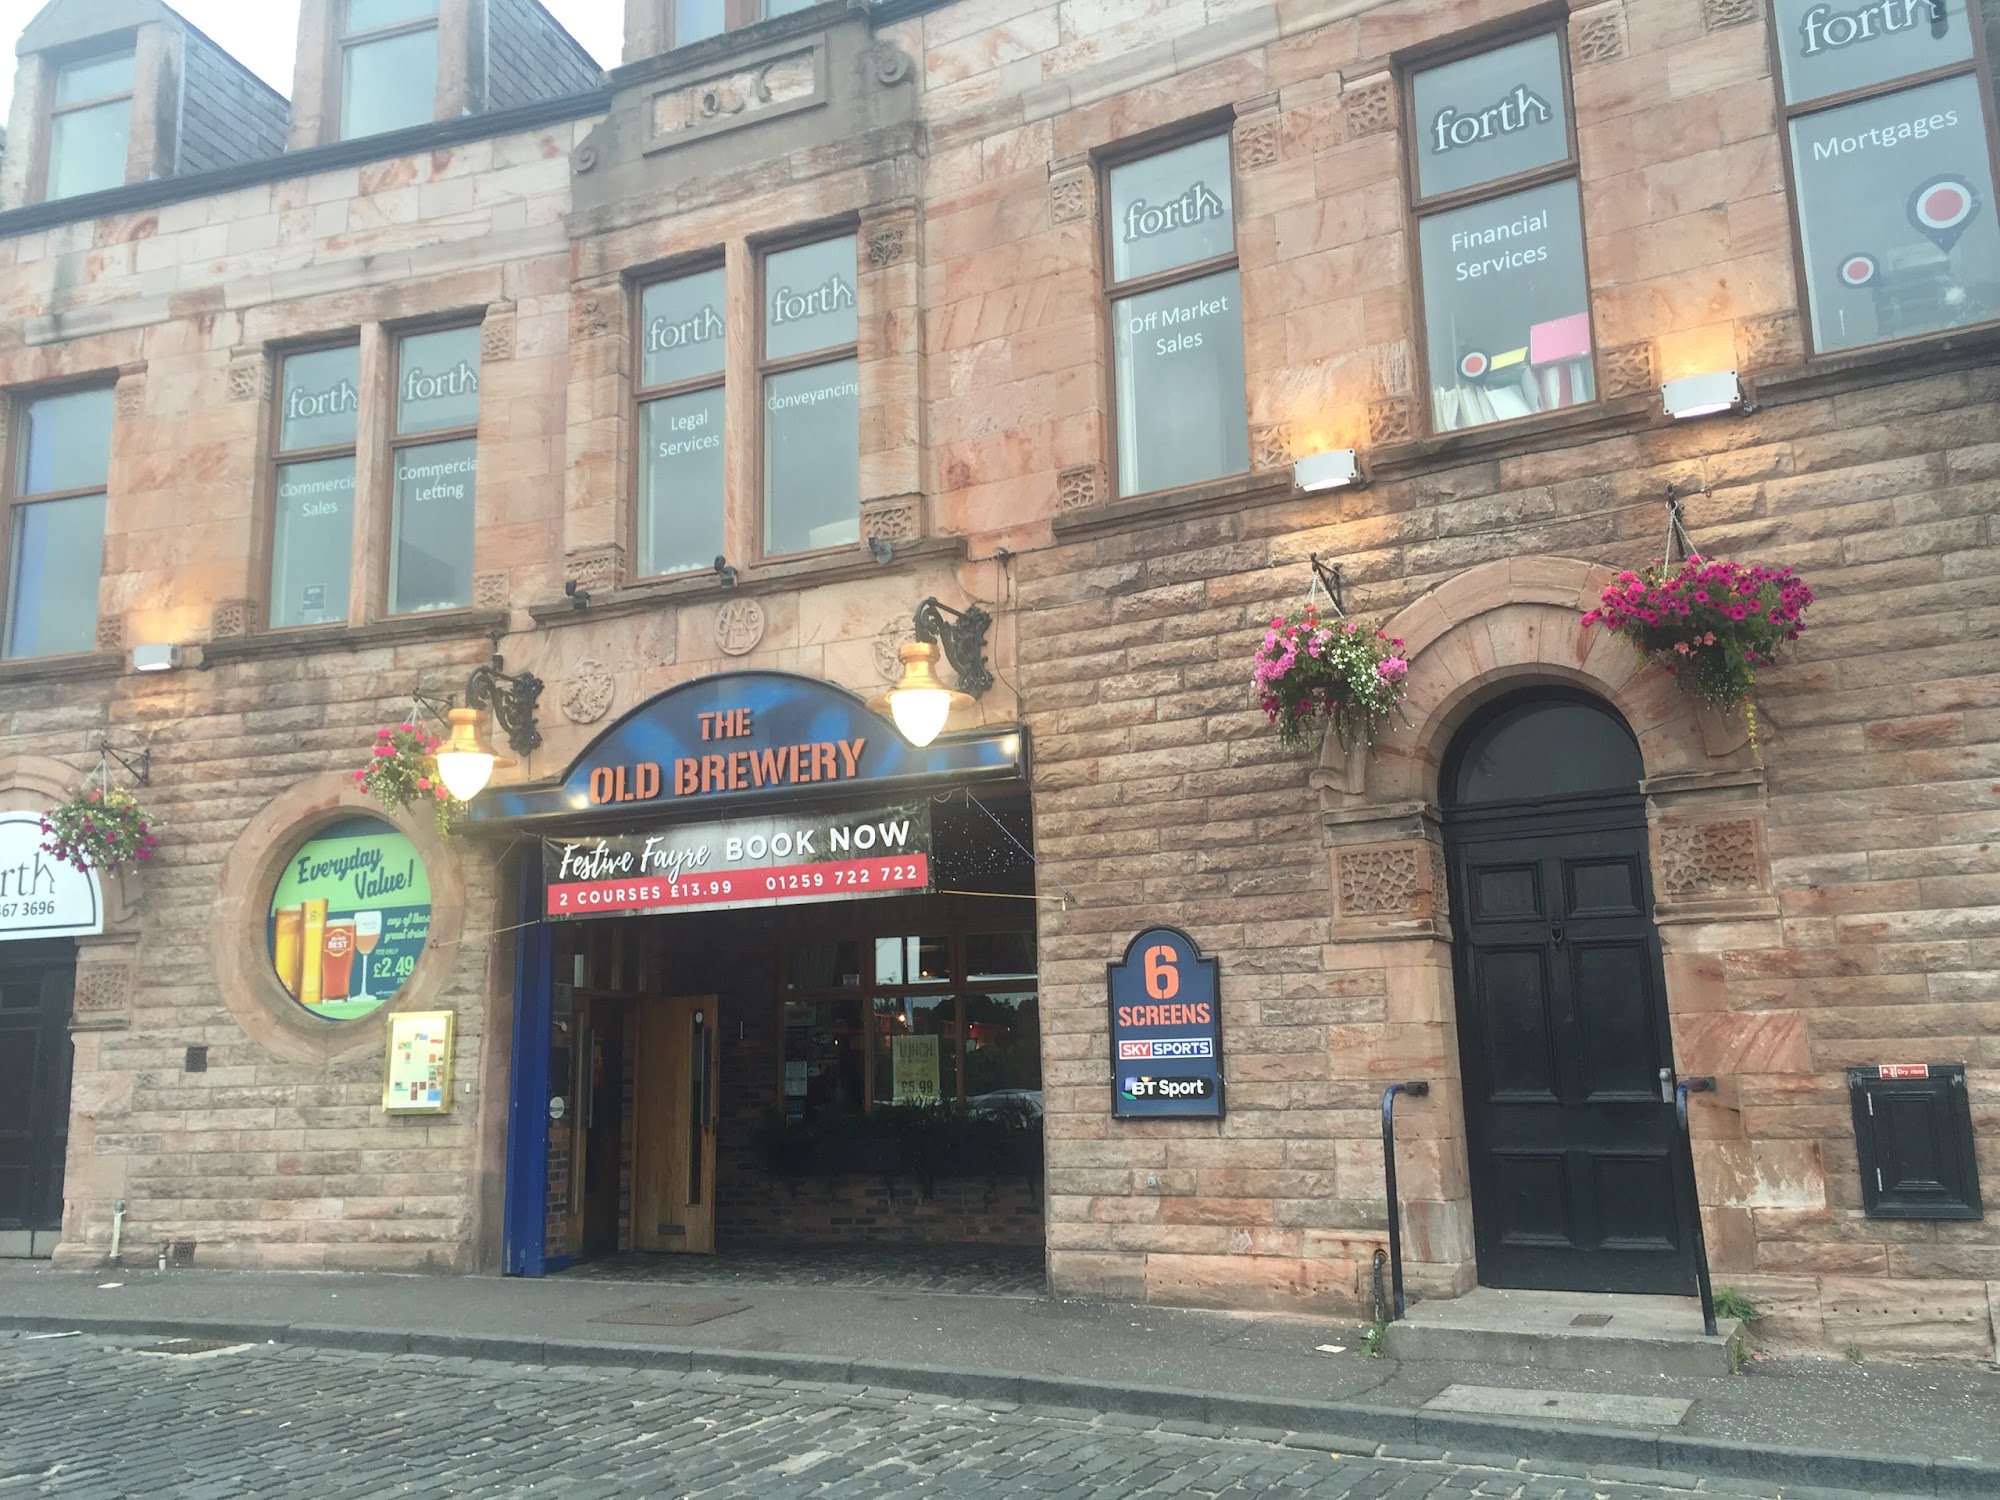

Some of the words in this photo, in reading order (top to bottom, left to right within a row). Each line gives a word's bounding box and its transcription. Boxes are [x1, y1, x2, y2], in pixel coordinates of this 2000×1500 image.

[1803, 0, 1940, 53] forth
[1435, 87, 1548, 151] forth
[1813, 110, 1958, 161] Mortgages
[1128, 184, 1219, 240] forth
[1451, 209, 1548, 252] Financial
[1456, 246, 1548, 281] Services
[774, 277, 854, 323] forth
[1130, 312, 1158, 334] Off
[1162, 296, 1228, 327] Market
[649, 307, 724, 351] forth
[1156, 332, 1203, 356] Sales
[288, 381, 357, 419] forth
[406, 363, 477, 400] forth
[670, 408, 708, 431] Legal
[659, 434, 720, 458] Services
[280, 473, 356, 498] Commercia
[398, 457, 478, 481] Commercia
[302, 501, 338, 517] Sales
[415, 484, 464, 501] Letting
[698, 708, 751, 741] THE
[589, 762, 660, 804] OLD
[674, 738, 866, 796] BREWERY
[297, 847, 383, 885] Everyday
[559, 839, 635, 880] Festive
[640, 836, 712, 885] Fayre
[726, 828, 815, 861] BOOK
[830, 820, 909, 852] NOW
[355, 859, 414, 900] Value!
[559, 893, 568, 906] 2
[577, 886, 661, 905] COURSES
[670, 880, 732, 898] £13.99
[766, 872, 824, 891] 01259
[835, 868, 870, 885] 722
[881, 865, 917, 882] 722
[0, 903, 18, 918] 67
[21, 900, 55, 916] 3696
[328, 940, 349, 949] BEST
[373, 956, 415, 978] £2.49
[1144, 945, 1179, 999] 6
[1118, 1002, 1211, 1027] SCREENS
[1122, 1043, 1151, 1056] SKY
[1153, 1041, 1210, 1056] SPORTS
[1131, 1081, 1158, 1095] BT
[1159, 1079, 1204, 1098] Sport
